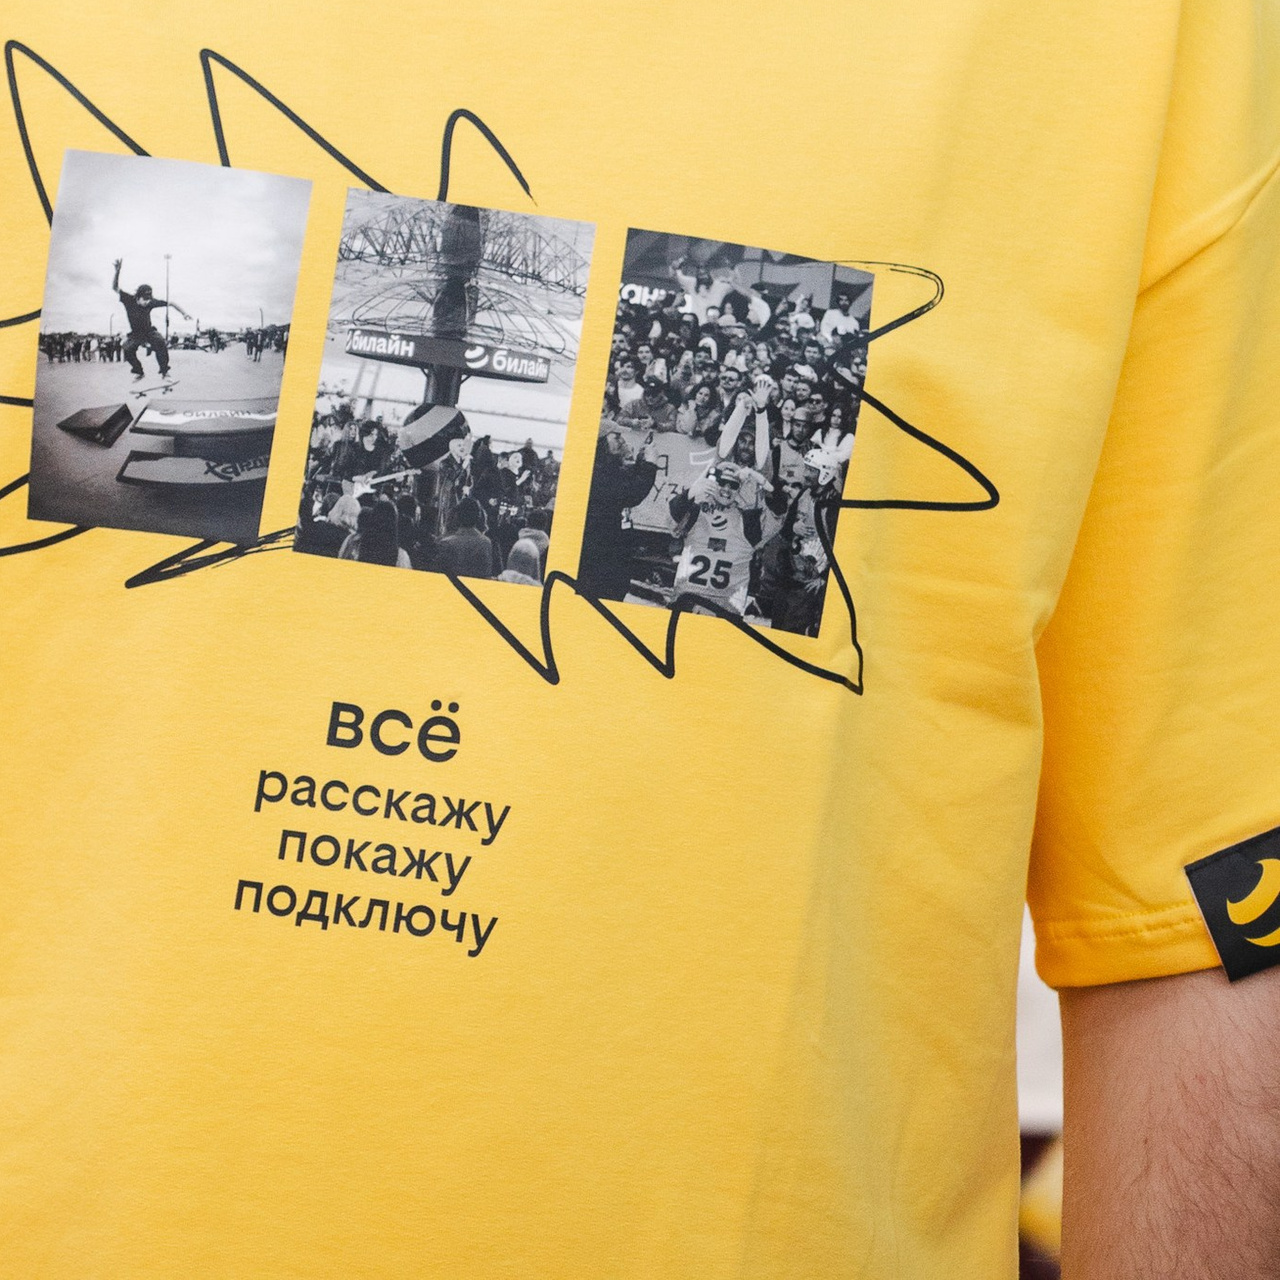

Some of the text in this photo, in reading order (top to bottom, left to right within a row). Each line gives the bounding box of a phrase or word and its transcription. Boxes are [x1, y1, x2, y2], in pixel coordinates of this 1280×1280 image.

[352, 329, 415, 358] билайн
[688, 555, 733, 589] 25
[326, 700, 461, 763] всё
[254, 770, 511, 846] расскажу
[278, 829, 472, 896] покажу
[234, 879, 499, 958] подключу
